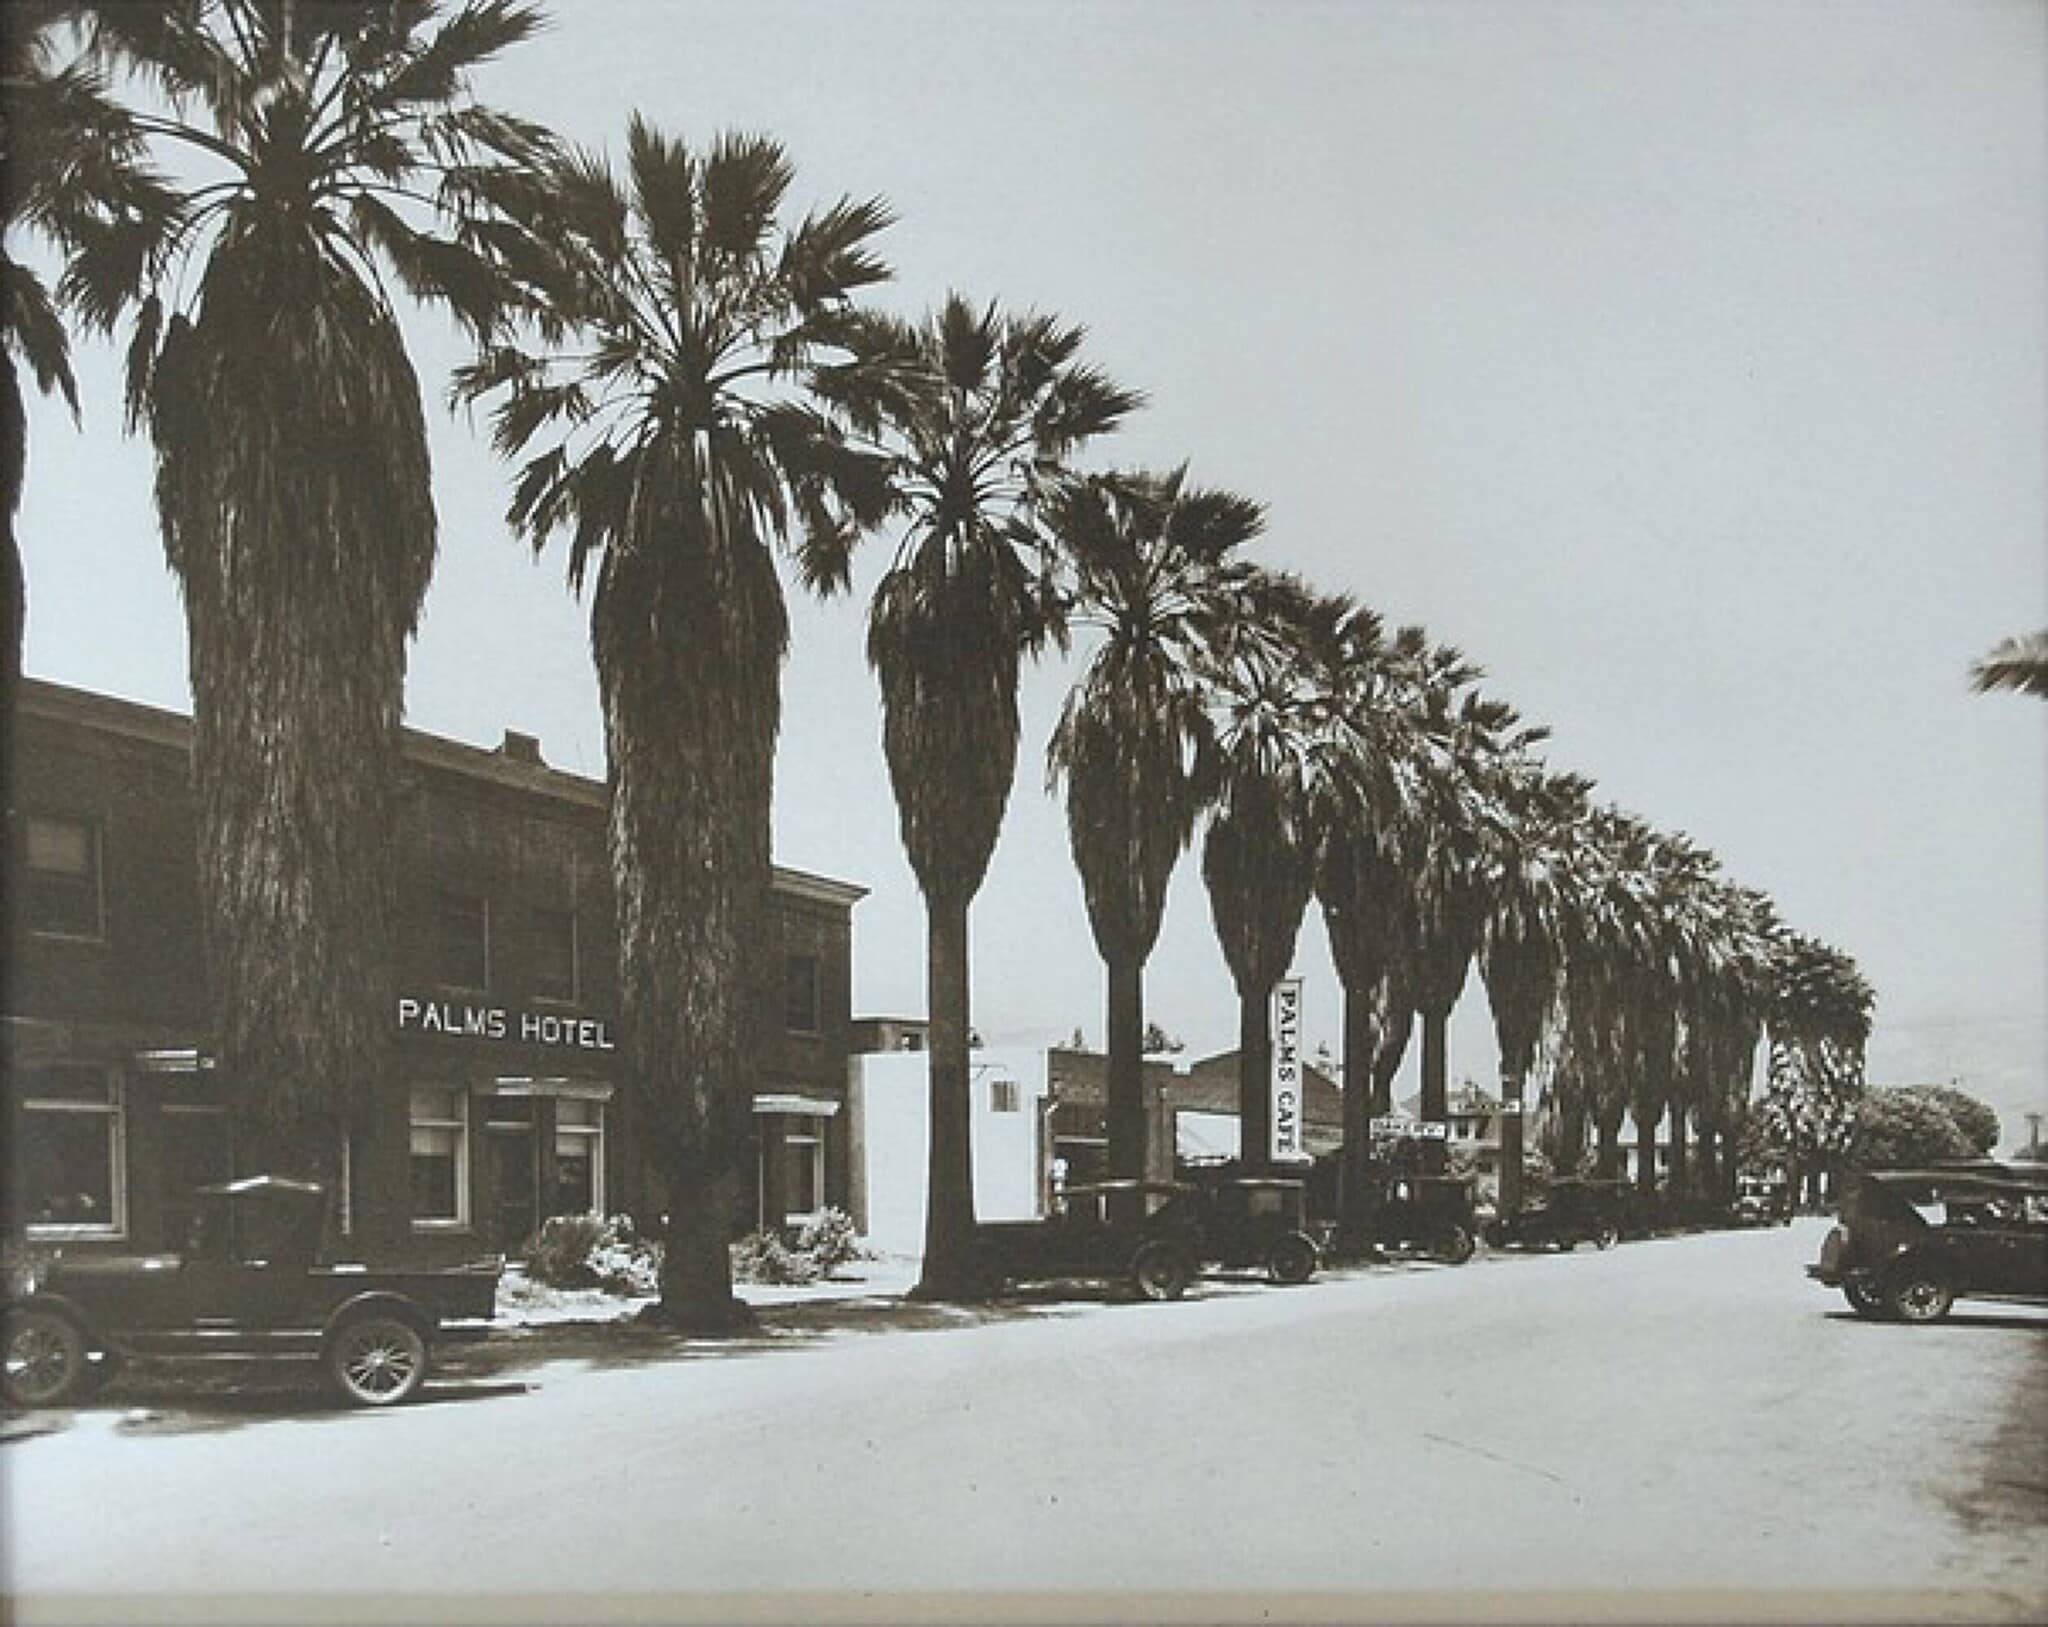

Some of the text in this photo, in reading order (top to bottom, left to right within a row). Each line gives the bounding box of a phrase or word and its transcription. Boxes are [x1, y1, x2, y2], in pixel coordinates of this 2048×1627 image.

[399, 999, 615, 1049] PALMS HOTEL
[1278, 990, 1296, 1153] PALMS CAFE
